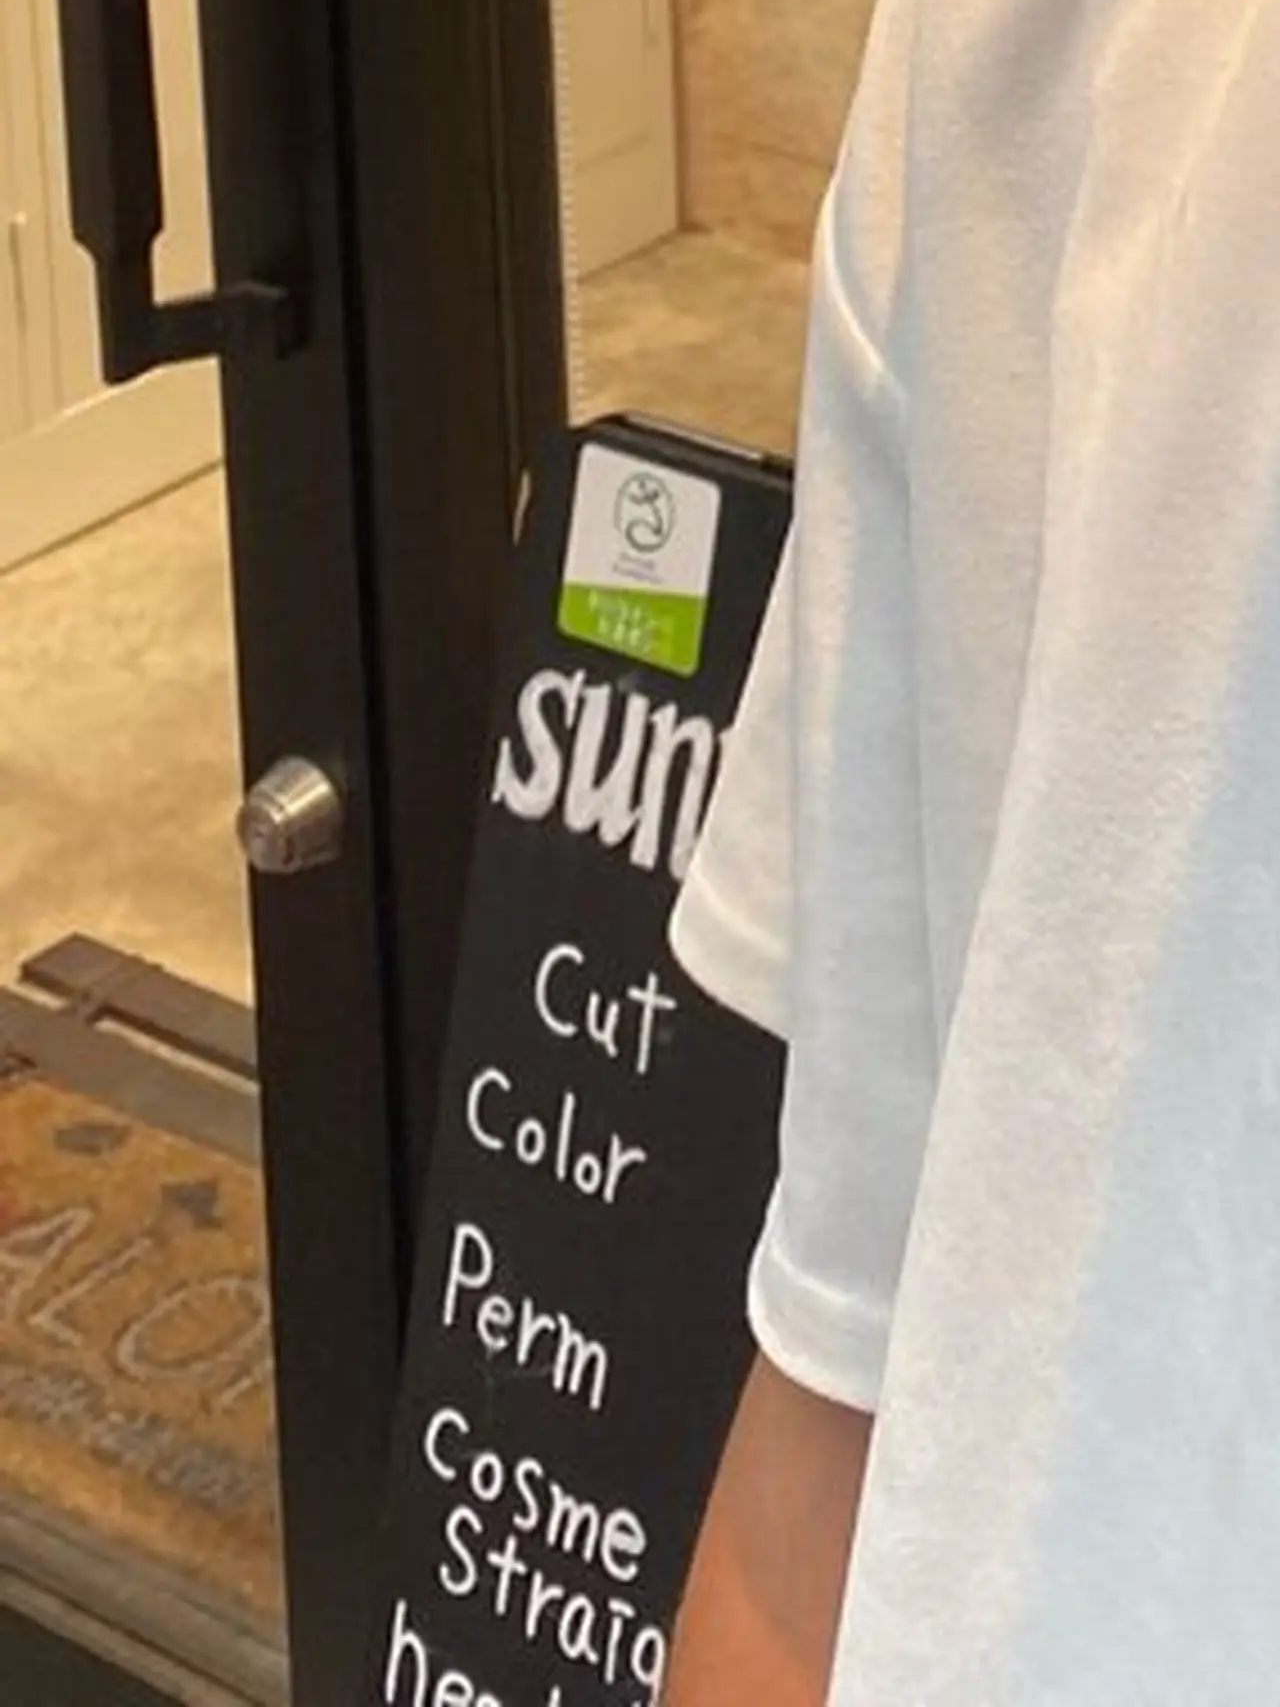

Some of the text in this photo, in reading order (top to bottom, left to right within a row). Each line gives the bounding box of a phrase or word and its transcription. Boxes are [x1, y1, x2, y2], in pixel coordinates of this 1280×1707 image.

[535, 943, 678, 1074] Cut
[467, 1067, 648, 1204] Color
[442, 1222, 609, 1411] Perm
[424, 1407, 648, 1582] Cosme
